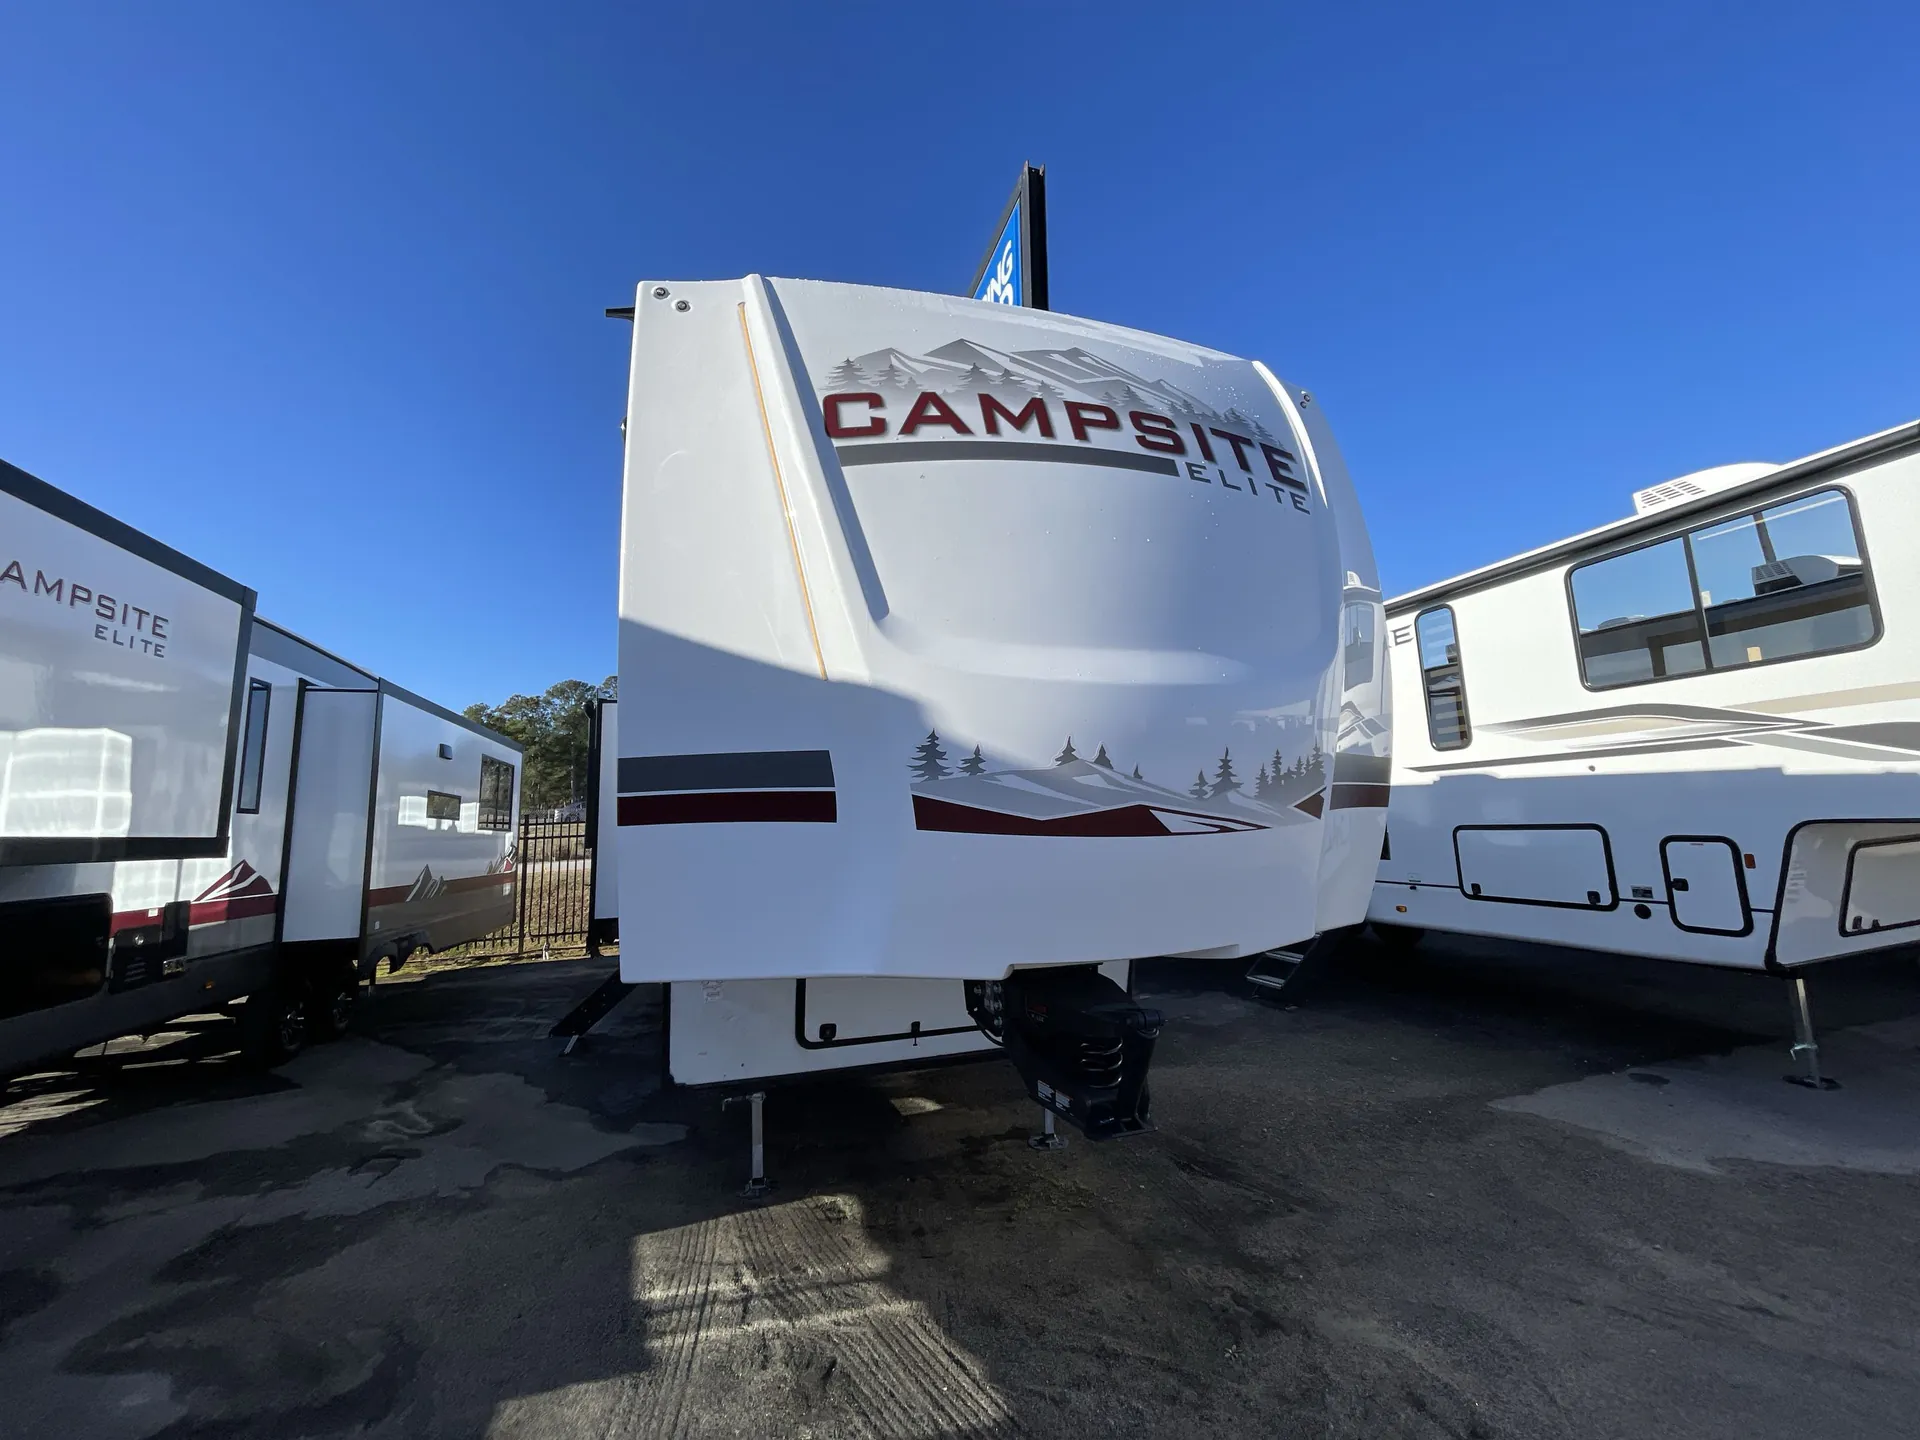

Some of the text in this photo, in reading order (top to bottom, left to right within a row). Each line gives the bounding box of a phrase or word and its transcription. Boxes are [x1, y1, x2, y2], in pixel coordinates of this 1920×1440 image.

[823, 391, 1309, 495] CAMPSITE
[1185, 461, 1311, 515] ELITE
[0, 560, 169, 640] AMPSITE
[94, 624, 166, 658] ELITE
[1389, 624, 1415, 648] E
